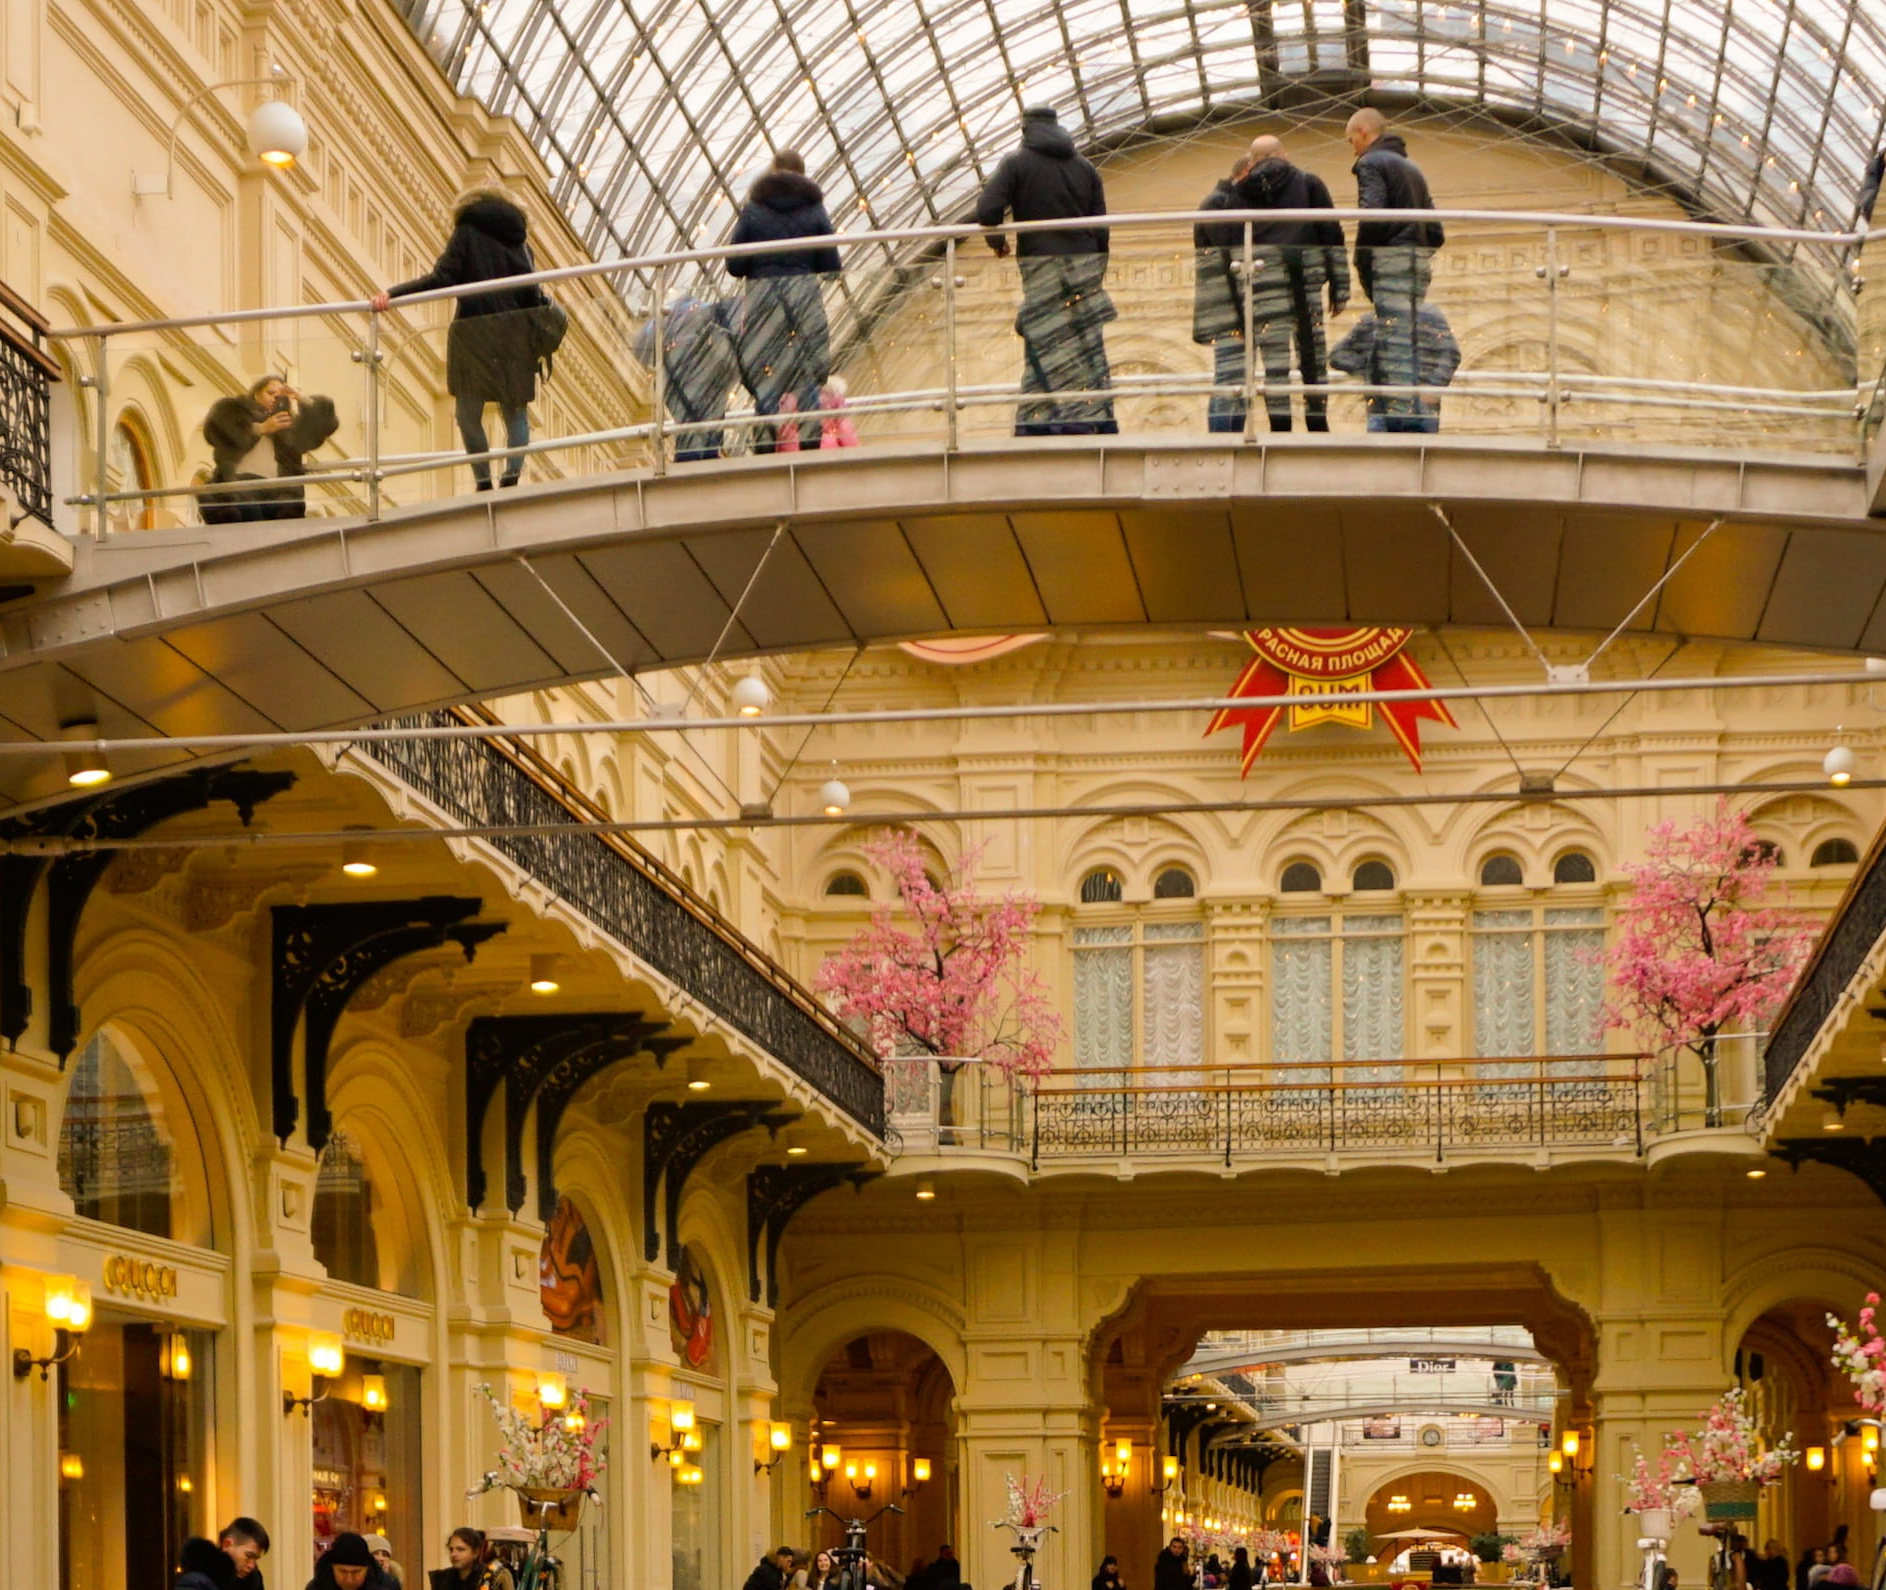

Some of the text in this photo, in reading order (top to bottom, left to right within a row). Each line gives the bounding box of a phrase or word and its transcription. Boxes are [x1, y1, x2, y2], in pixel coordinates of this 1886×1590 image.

[1255, 628, 1405, 671] РАСНАЯ ПЛОЩАД
[104, 1255, 178, 1297] GUCCI
[1417, 1360, 1450, 1373] Dior
